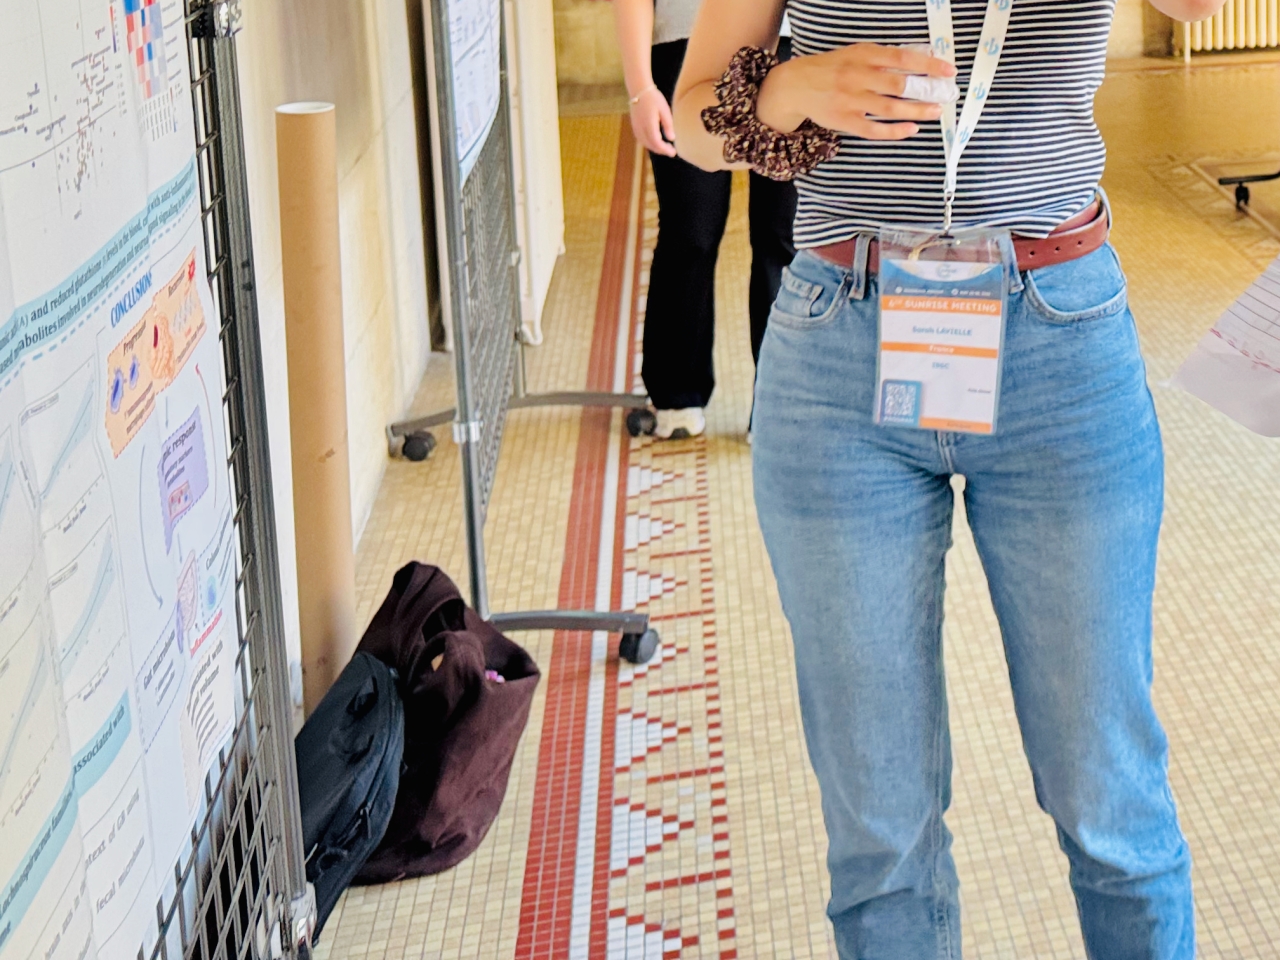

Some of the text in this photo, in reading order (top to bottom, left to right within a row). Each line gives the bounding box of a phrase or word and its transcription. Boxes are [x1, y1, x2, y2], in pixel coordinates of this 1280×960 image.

[31, 299, 49, 323] and
[50, 279, 75, 312] reduced
[904, 299, 948, 311] SUNRISE
[950, 301, 997, 313] MEETING
